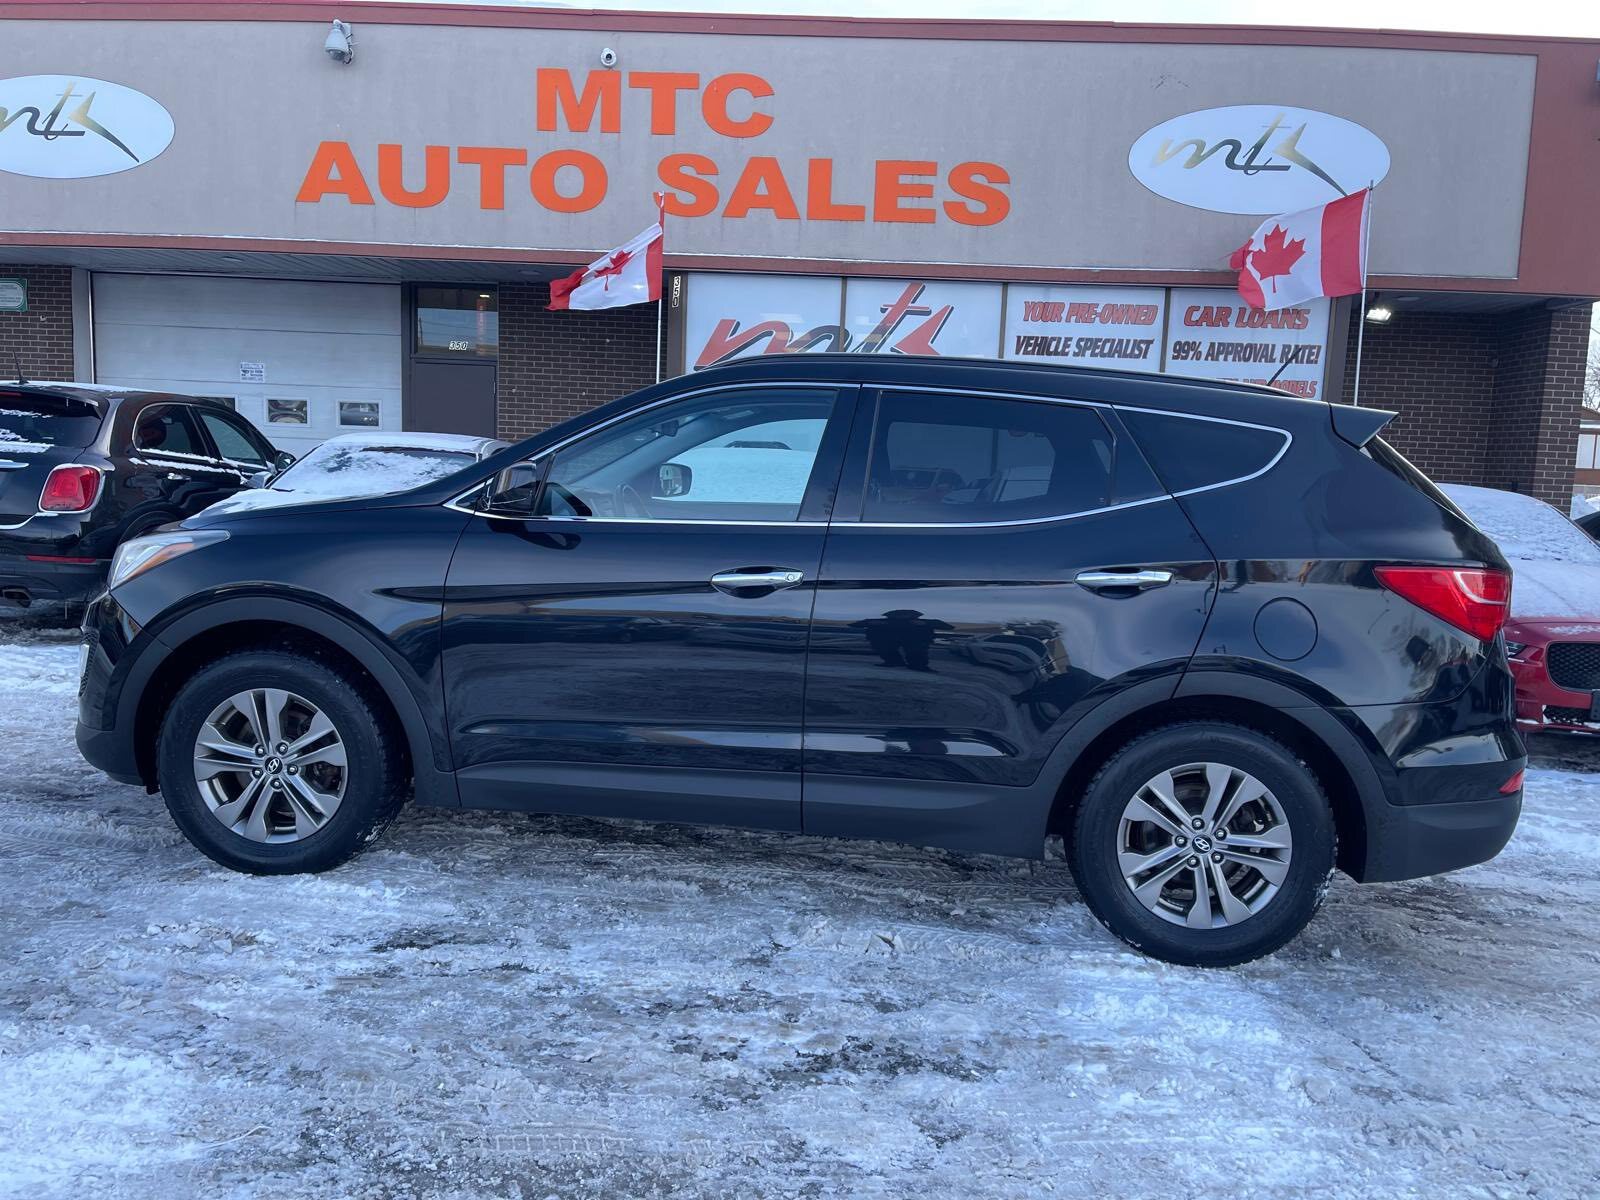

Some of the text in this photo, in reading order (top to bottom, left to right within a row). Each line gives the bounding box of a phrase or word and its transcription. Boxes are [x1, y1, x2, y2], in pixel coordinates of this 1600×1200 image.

[536, 68, 775, 138] MTC
[295, 141, 1011, 226] AUTO SALES
[672, 276, 681, 307] 350
[1023, 301, 1159, 326] YOUR PRE-OWNED
[1184, 305, 1311, 330] CAR LOANS
[449, 340, 469, 351] 350
[1015, 335, 1155, 360] VEHICLE SPECIALIST
[1172, 340, 1322, 365] 99% APPROVAL RATE!
